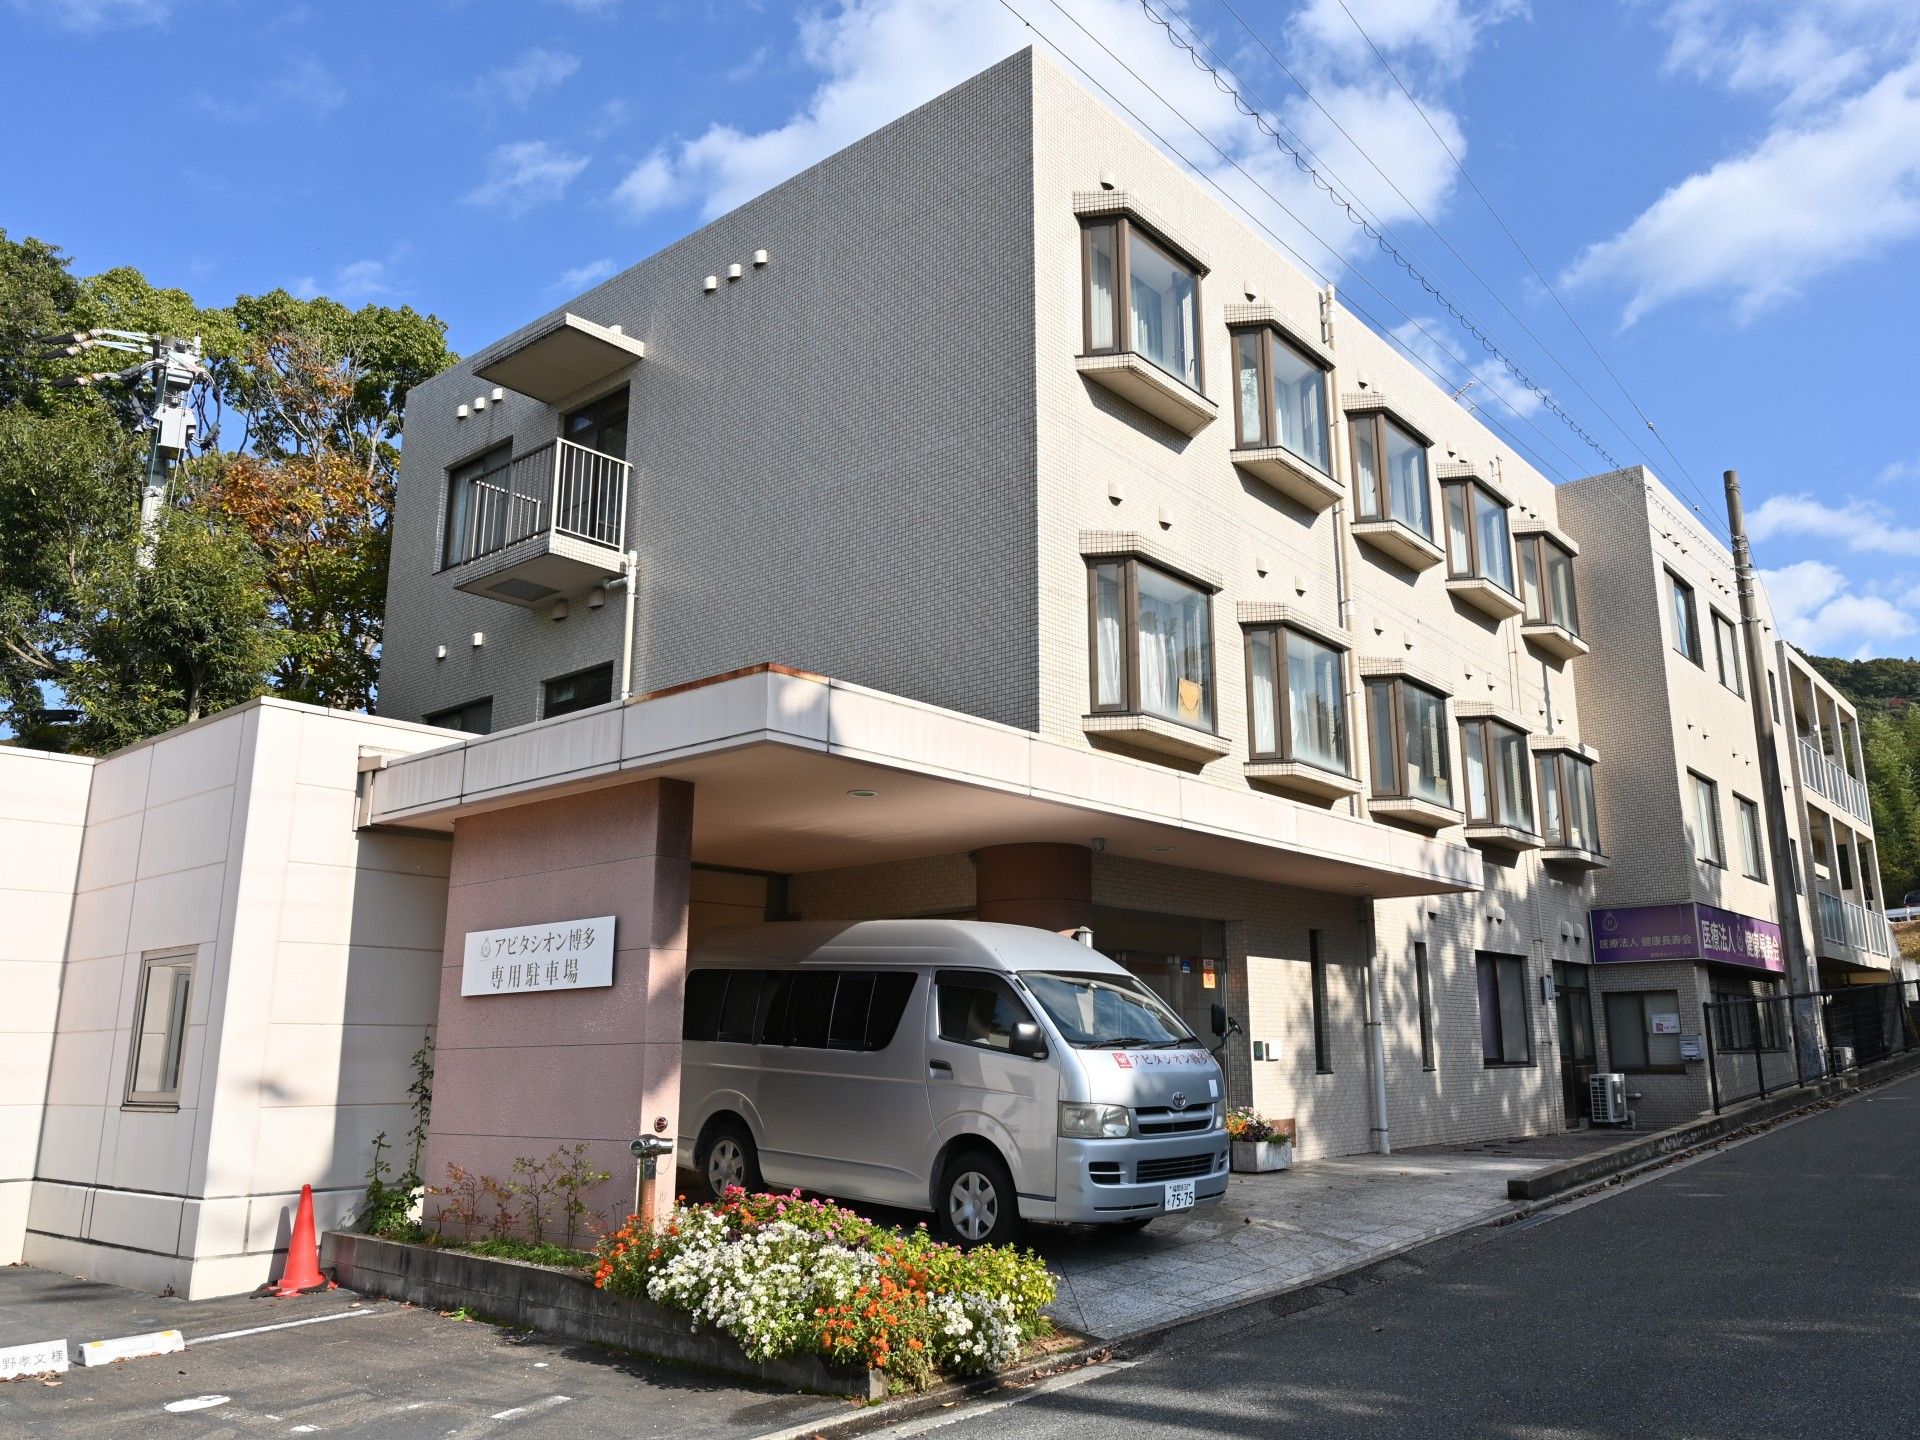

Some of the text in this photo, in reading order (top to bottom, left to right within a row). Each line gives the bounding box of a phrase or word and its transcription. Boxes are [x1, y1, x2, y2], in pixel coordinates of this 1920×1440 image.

[495, 927, 596, 957] アビタシオン博多
[1600, 934, 1692, 949] 医療法人 健康長寿会
[1701, 920, 1736, 953] 医療法人
[491, 958, 579, 990] 専用駐車場
[1172, 1191, 1193, 1208] 75-75
